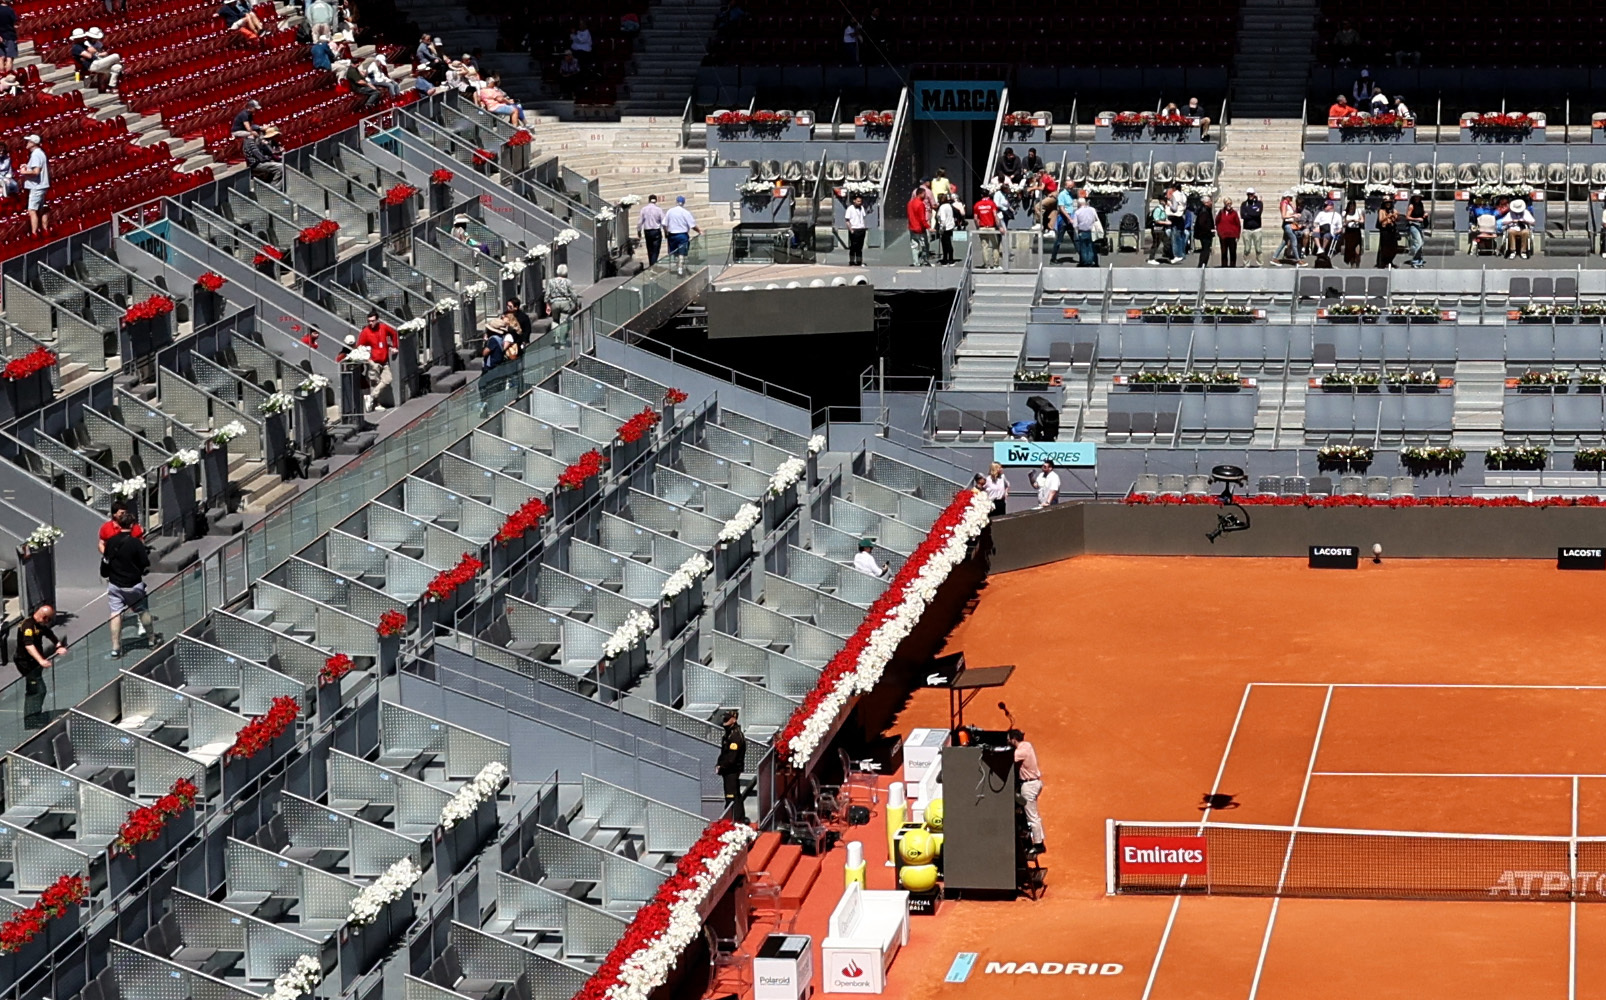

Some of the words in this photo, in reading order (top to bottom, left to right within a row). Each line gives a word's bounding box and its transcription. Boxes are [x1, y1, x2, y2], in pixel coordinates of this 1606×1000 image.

[922, 89, 1000, 111] MARCA
[1030, 452, 1081, 462] SCORES
[1314, 548, 1352, 556] LACOSTE
[1563, 549, 1602, 557] LACOSTE
[1124, 846, 1203, 863] Emirates
[1486, 870, 1570, 896] ATP
[984, 962, 1124, 975] MADRID
[760, 976, 790, 984] Polaroid
[834, 980, 870, 988] Openbank
